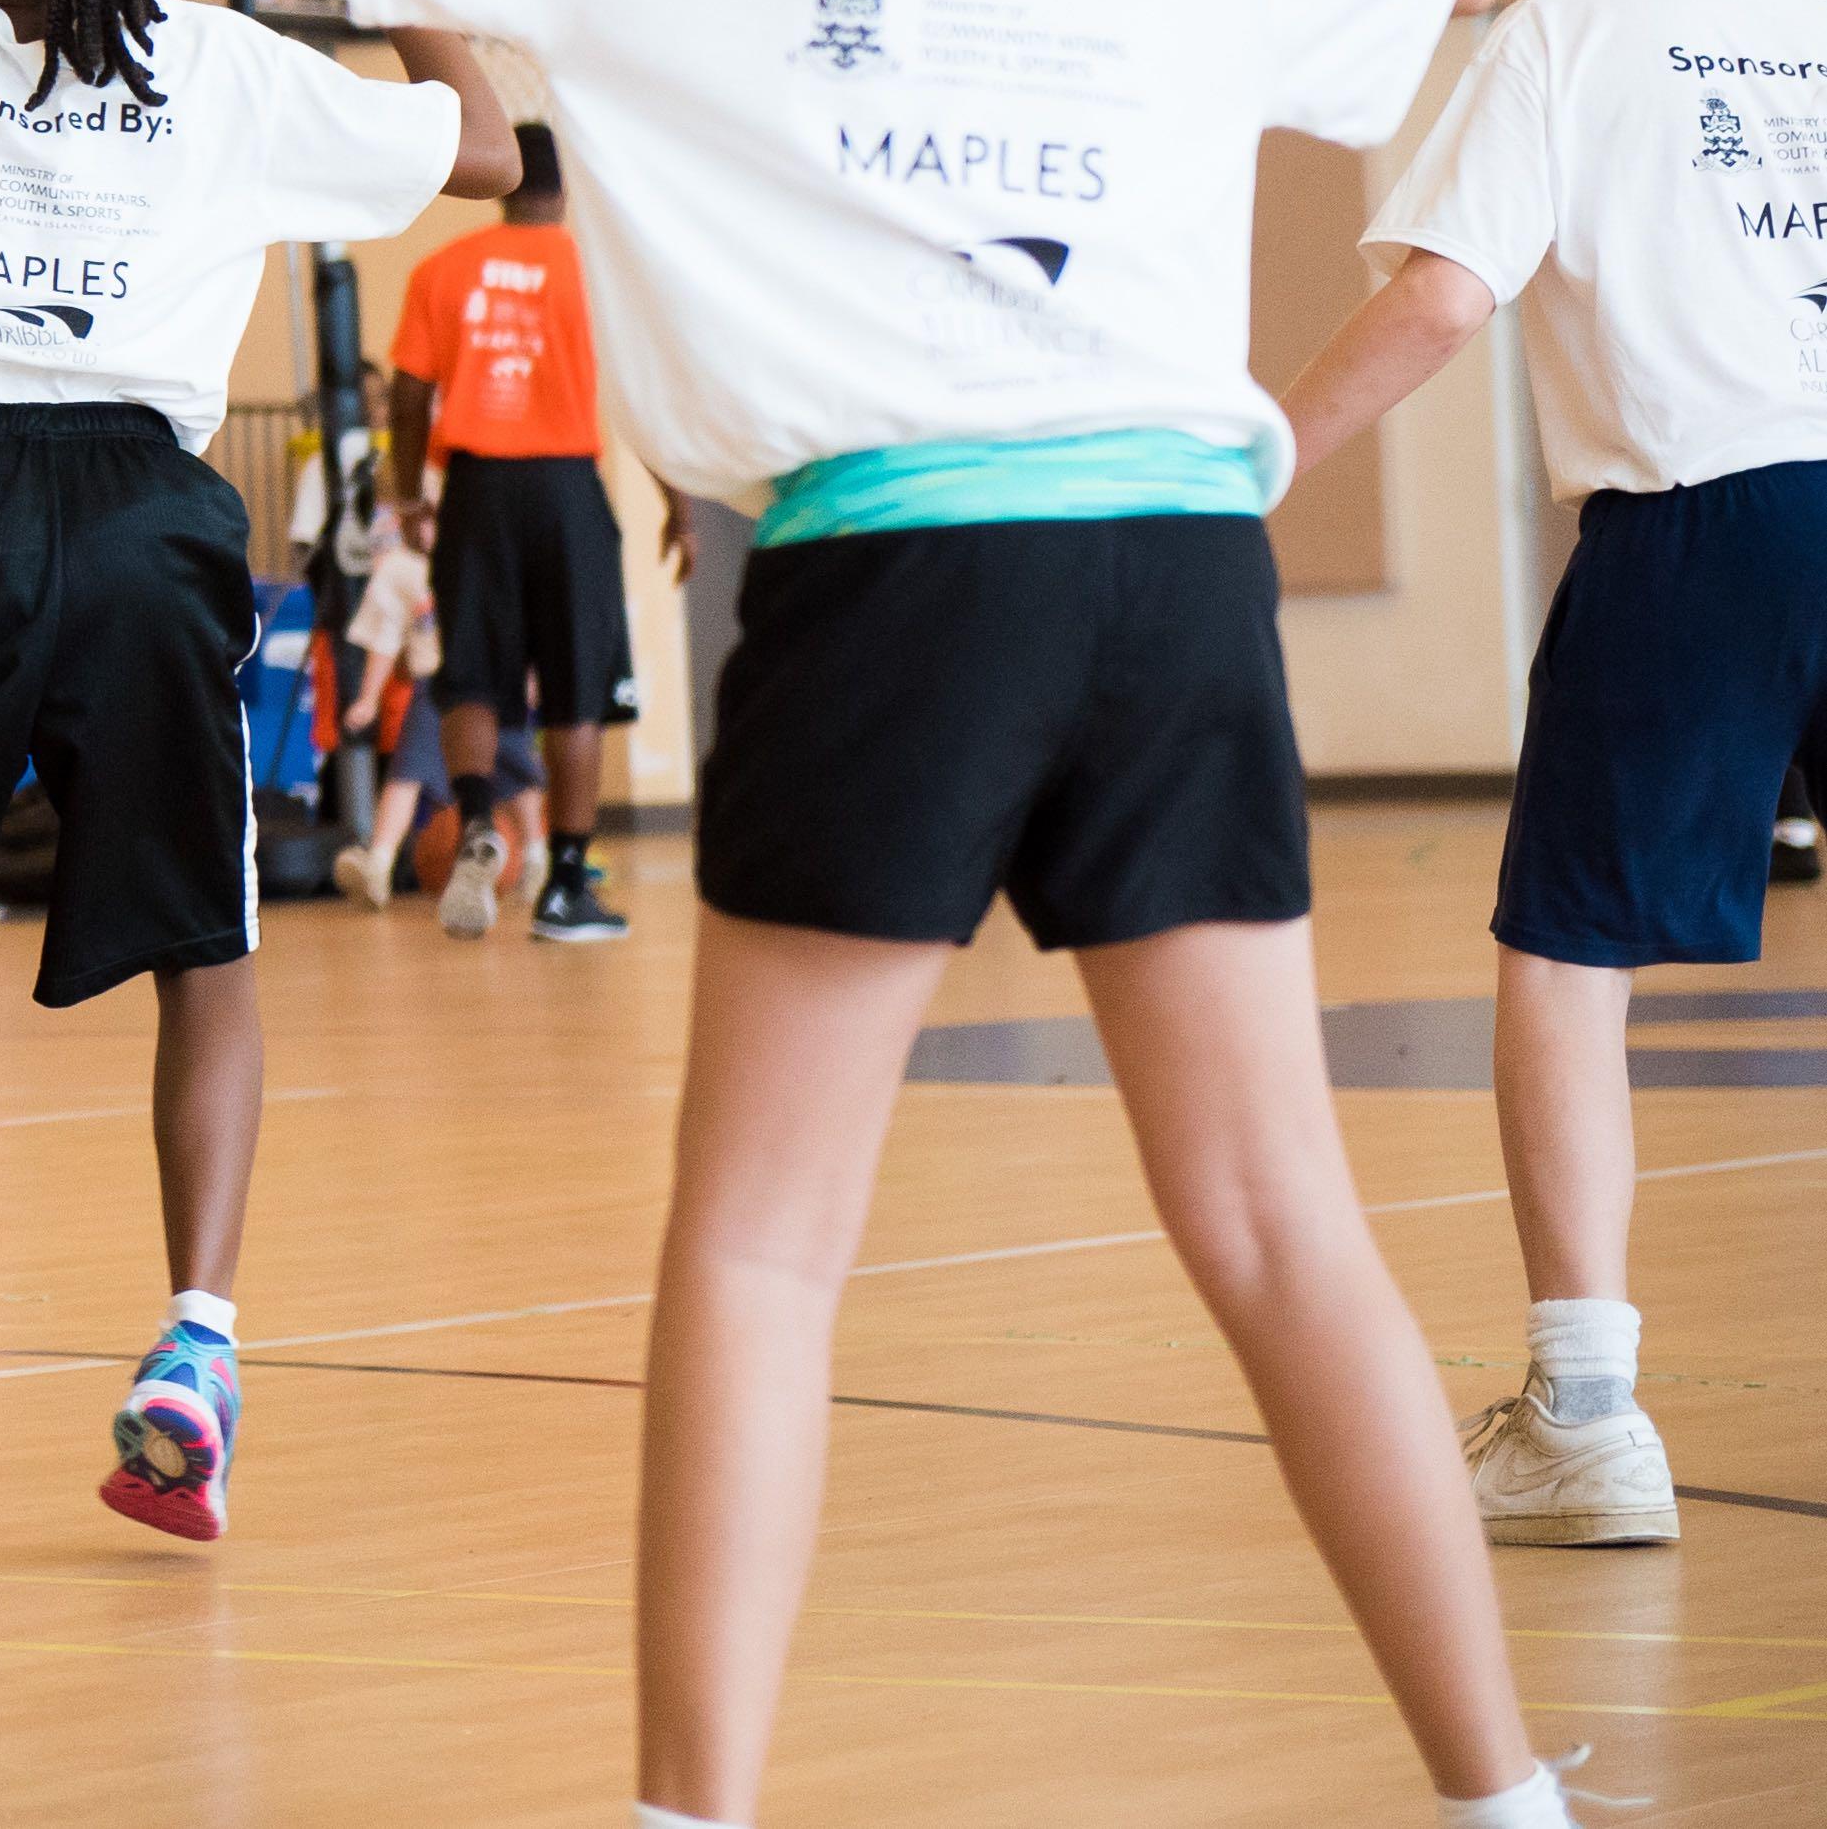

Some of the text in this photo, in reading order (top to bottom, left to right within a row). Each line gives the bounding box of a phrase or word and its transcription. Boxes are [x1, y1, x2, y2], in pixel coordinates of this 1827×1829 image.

[120, 102, 173, 143] By:
[0, 164, 57, 183] MINISTRY
[838, 124, 1107, 203] MAPLES
[51, 204, 64, 216] &
[67, 205, 122, 221] SPORTS
